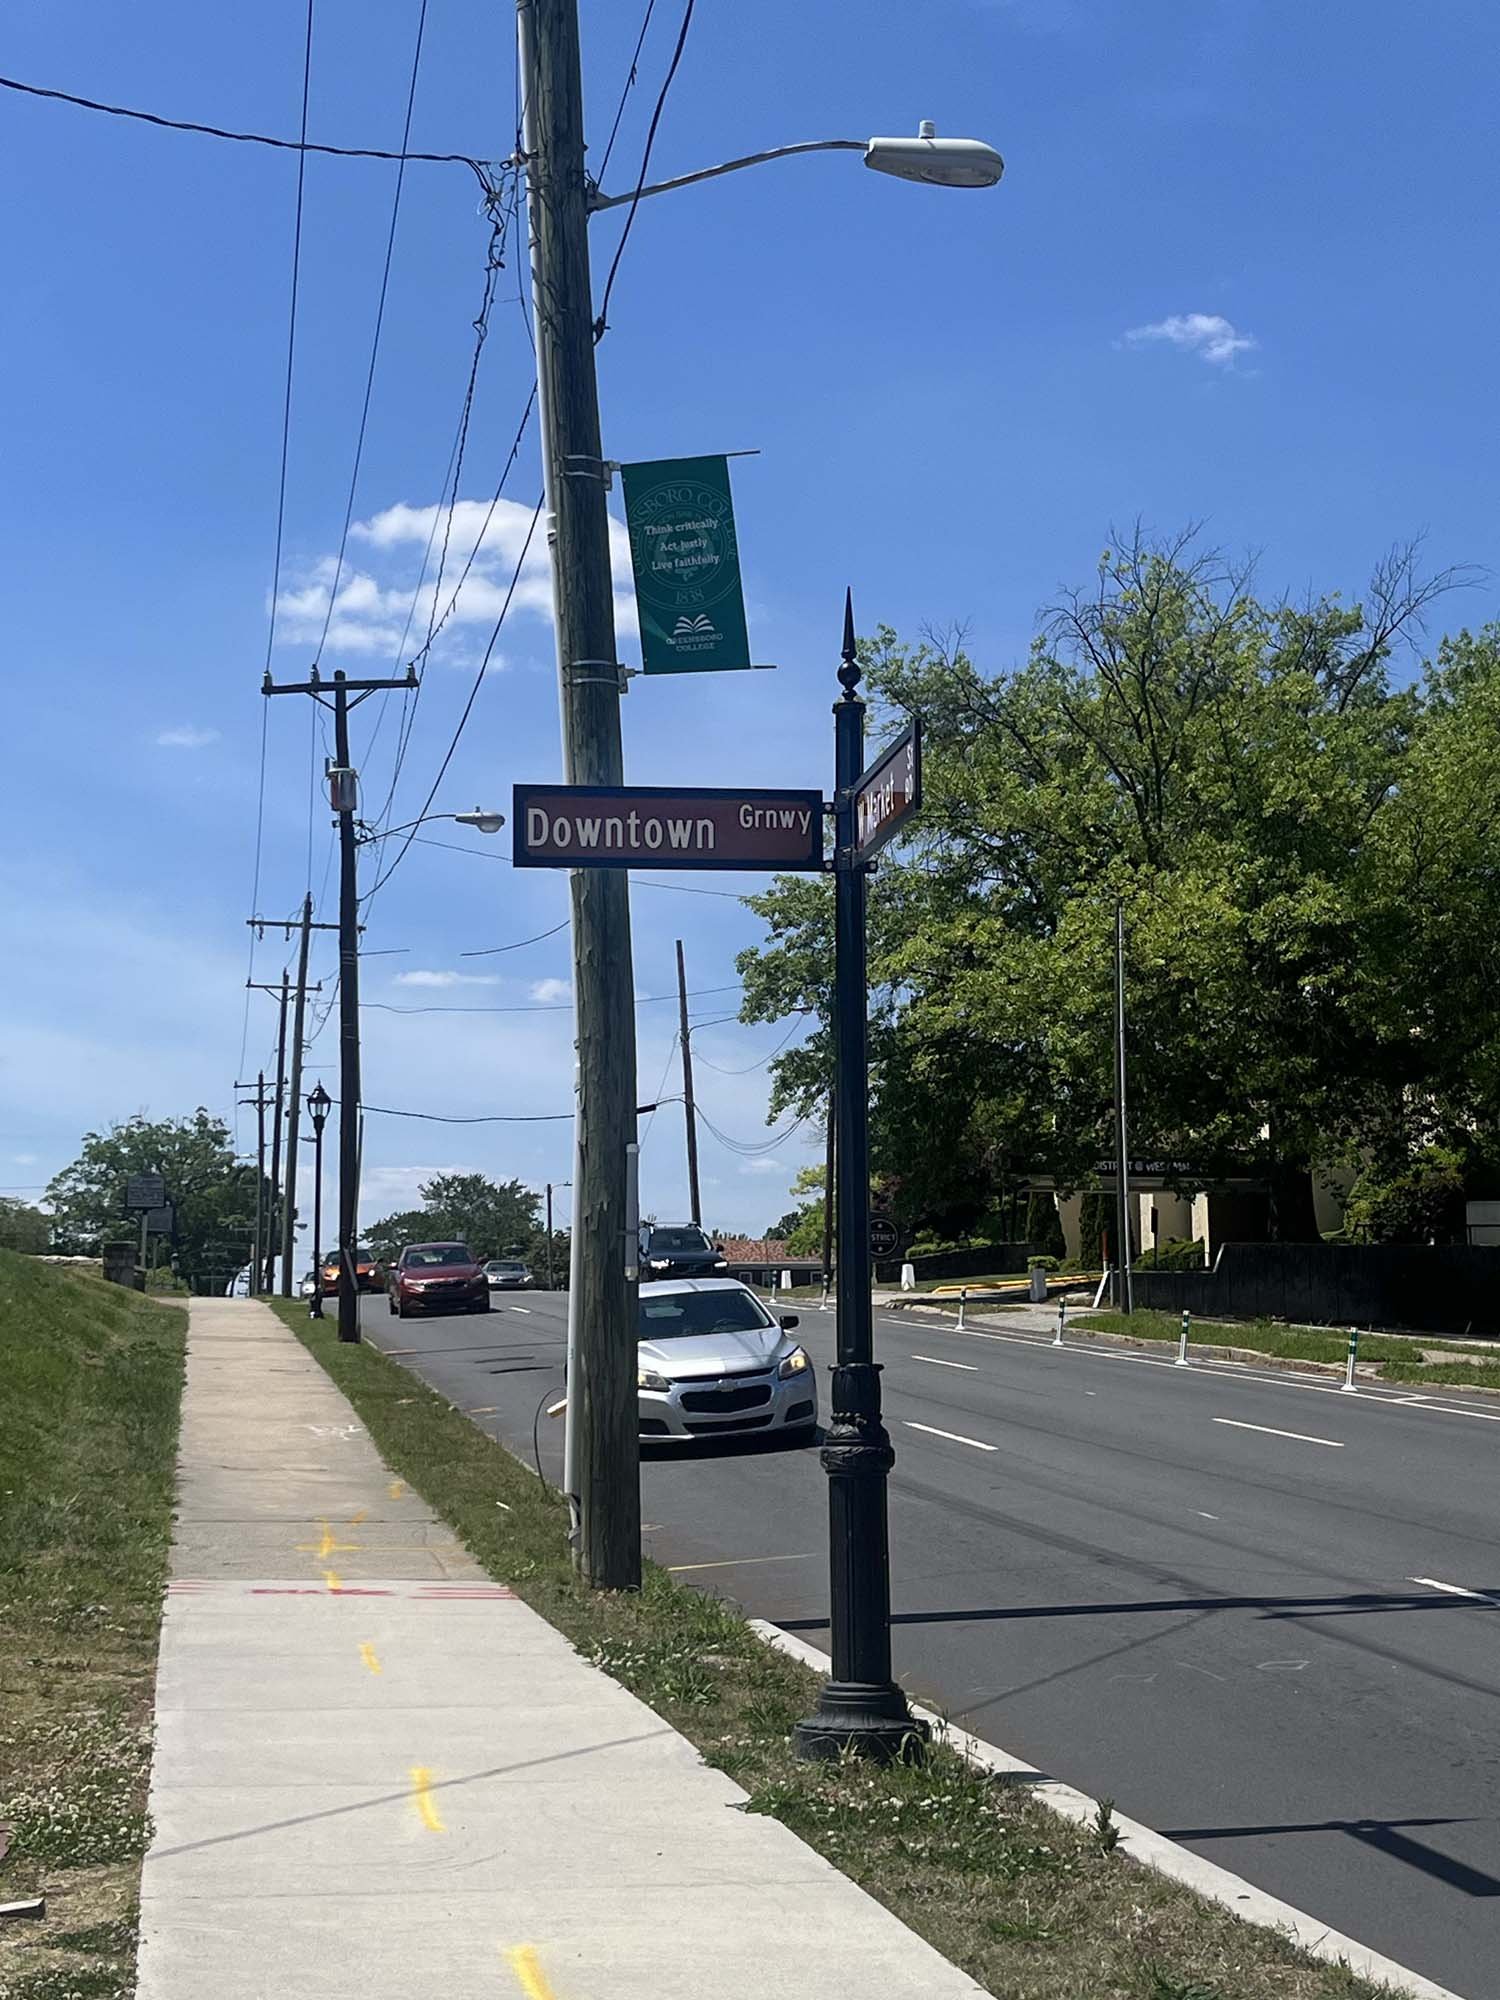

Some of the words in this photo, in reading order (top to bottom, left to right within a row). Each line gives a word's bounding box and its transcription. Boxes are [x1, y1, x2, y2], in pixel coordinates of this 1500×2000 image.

[644, 523, 673, 536] Think
[674, 518, 719, 532] critically
[659, 541, 677, 552] Act
[680, 537, 708, 552] justly
[651, 560, 673, 571] Live
[674, 553, 720, 568] faithfully
[674, 587, 705, 605] 1838
[866, 772, 895, 834] Market
[527, 807, 715, 849] Downtown
[739, 803, 812, 835] Grnwy
[1093, 1160, 1133, 1172] DISTRT
[1145, 1160, 1171, 1172] WES
[871, 1233, 895, 1242] STRICT
